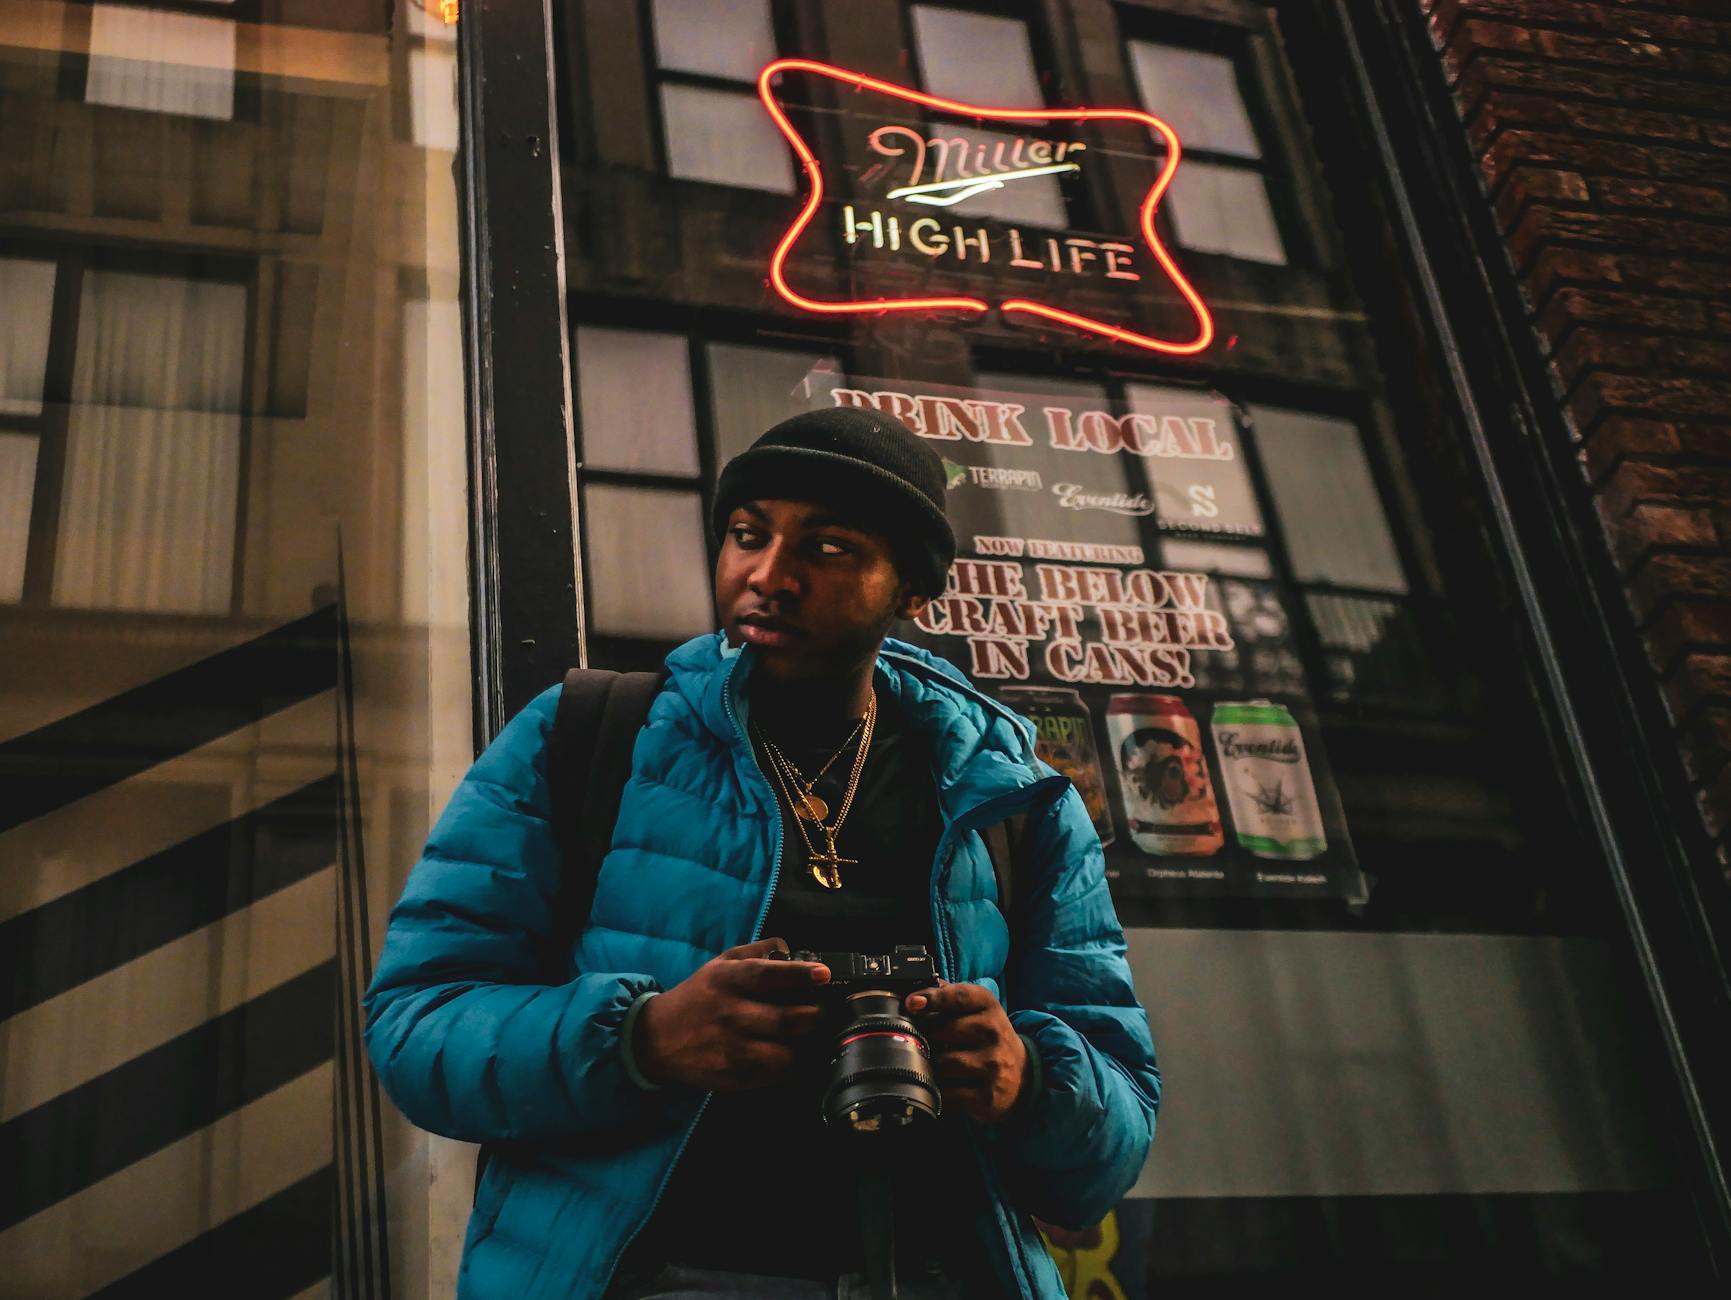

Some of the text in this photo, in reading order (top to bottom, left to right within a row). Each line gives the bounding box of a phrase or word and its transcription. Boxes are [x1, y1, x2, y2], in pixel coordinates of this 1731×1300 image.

[868, 126, 1088, 186] Miller
[843, 205, 1141, 281] HIGH LIFE
[1043, 406, 1234, 461] LOCAL
[1052, 483, 1156, 516] Eventide
[974, 535, 1144, 564] NOW FEATURING
[947, 558, 1208, 610] HE BELOW
[914, 596, 1235, 651] CRAFT BEER
[967, 636, 1195, 687] IN CANS!
